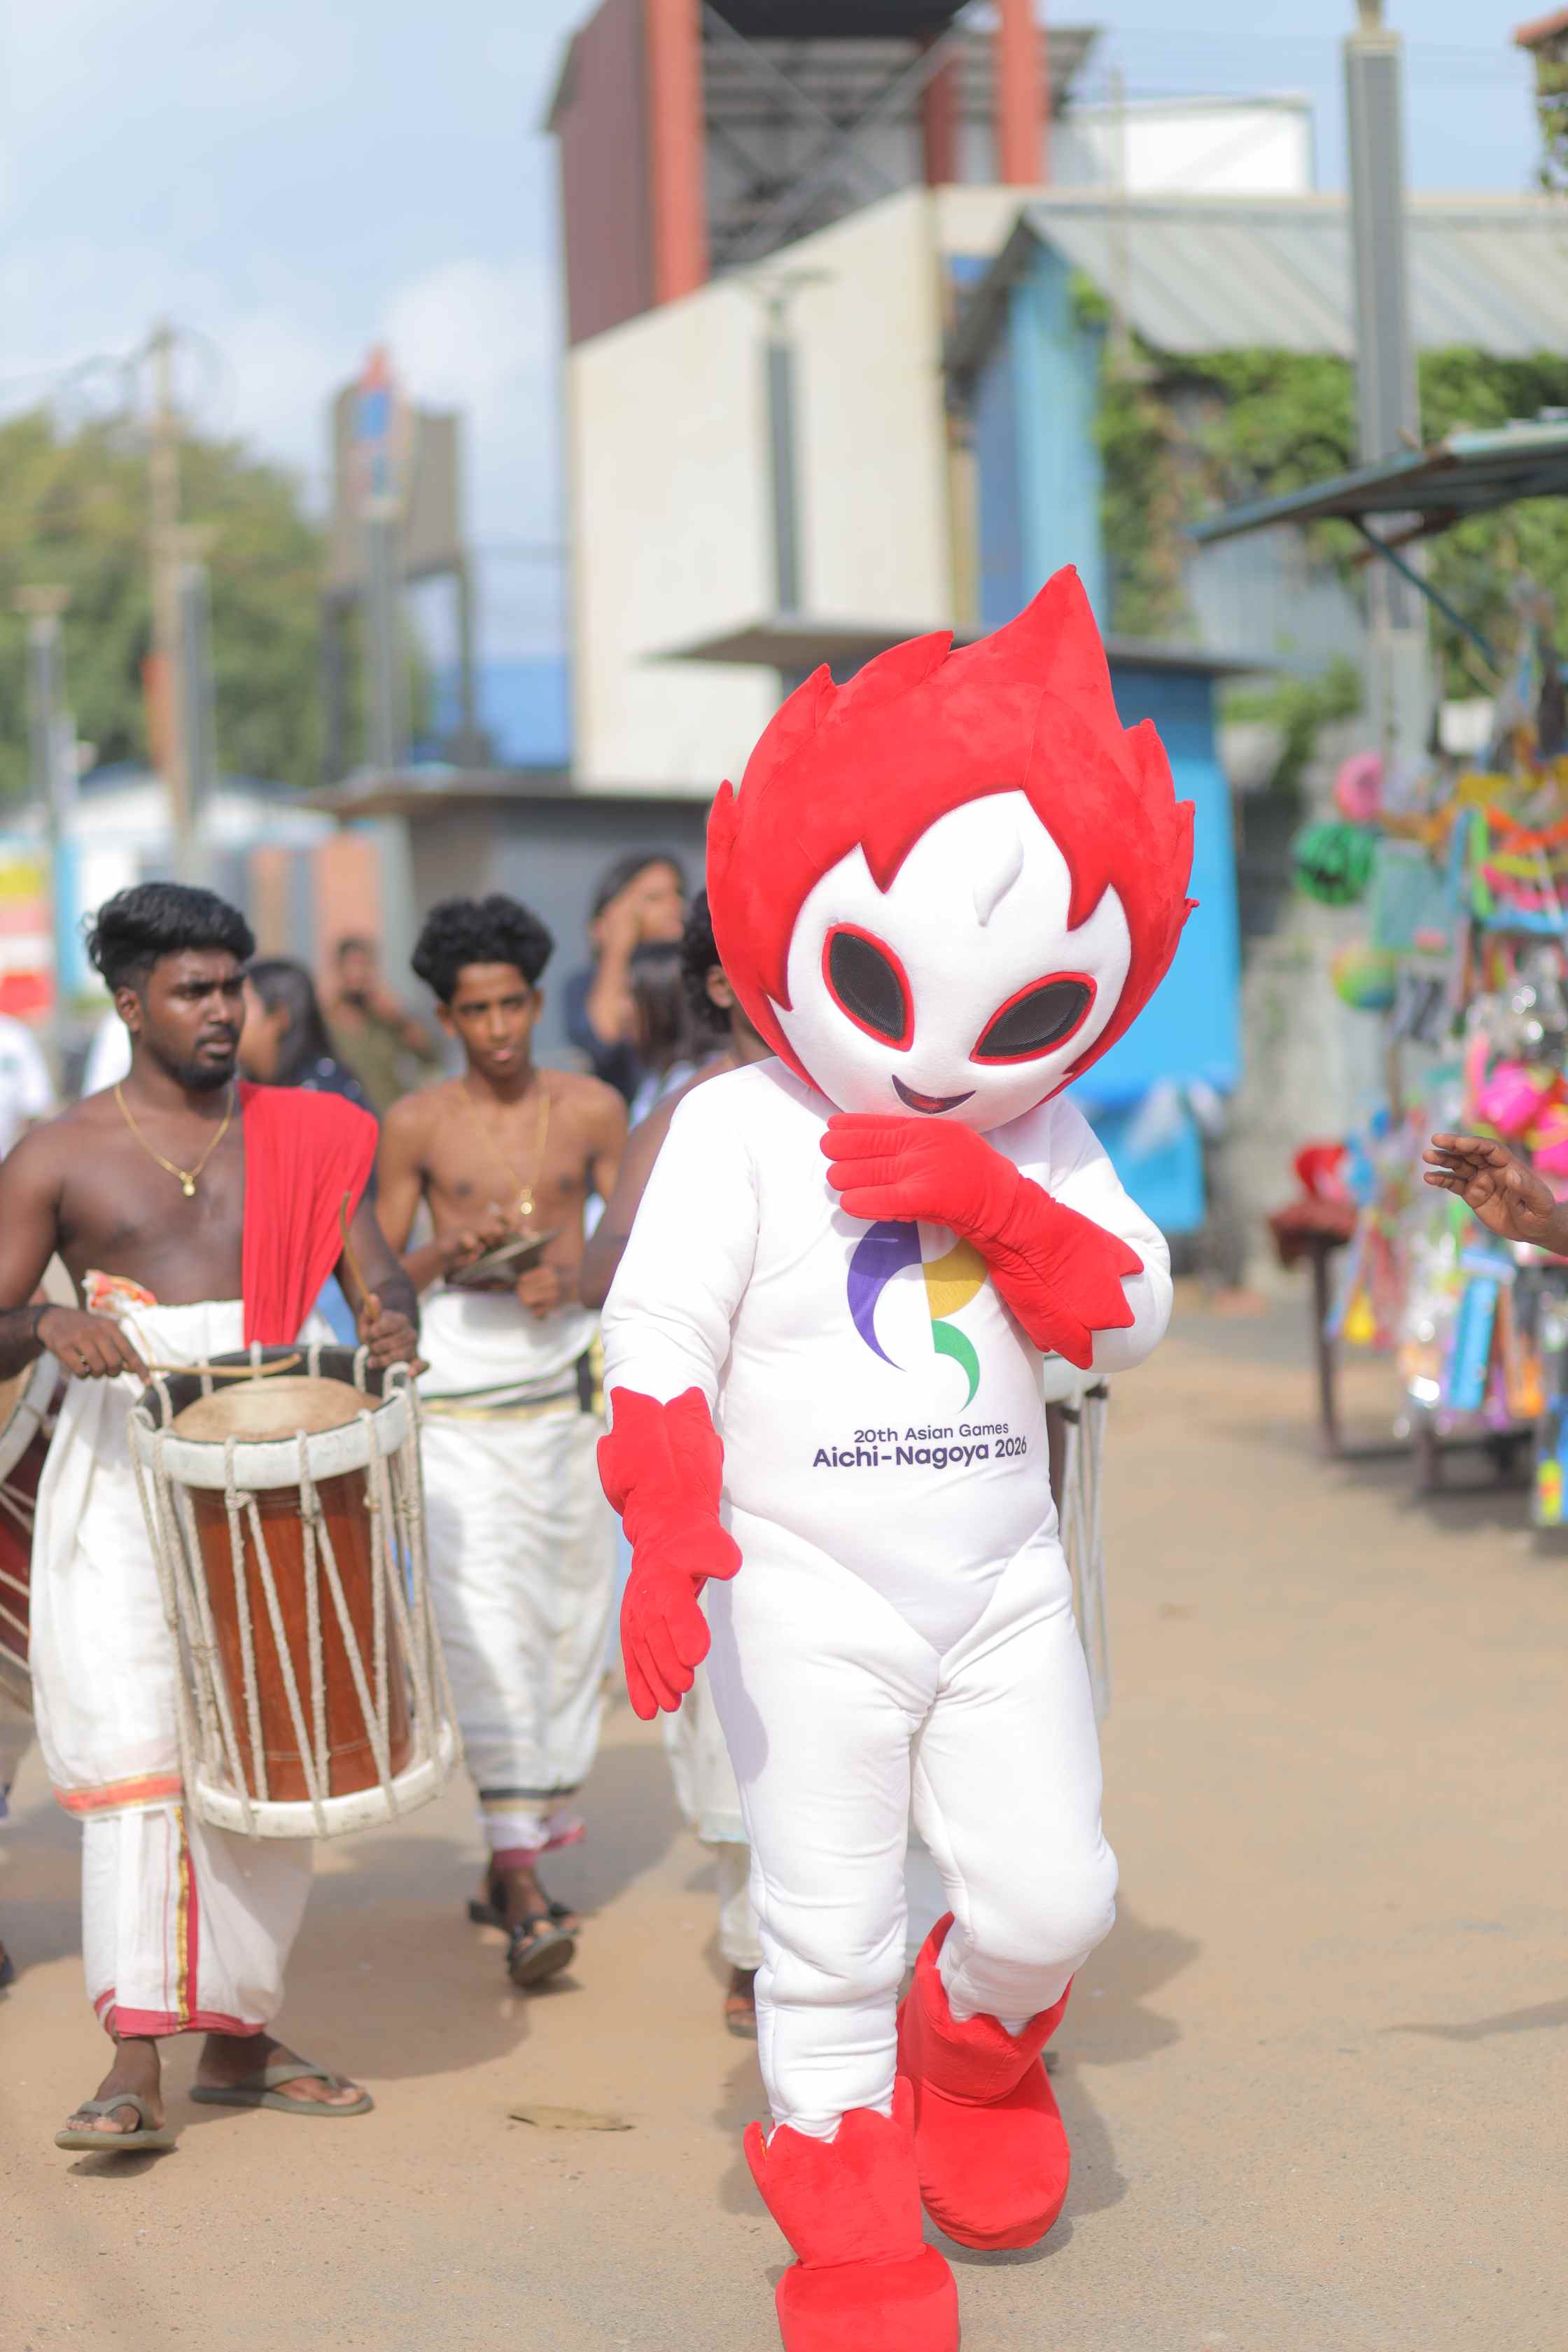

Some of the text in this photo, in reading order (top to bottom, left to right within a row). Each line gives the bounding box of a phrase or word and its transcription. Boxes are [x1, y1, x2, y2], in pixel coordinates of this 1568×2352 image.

[854, 1423, 1009, 1443] 20th Asian Games
[813, 1436, 1027, 1470] Aichi-Nagoya 2026
